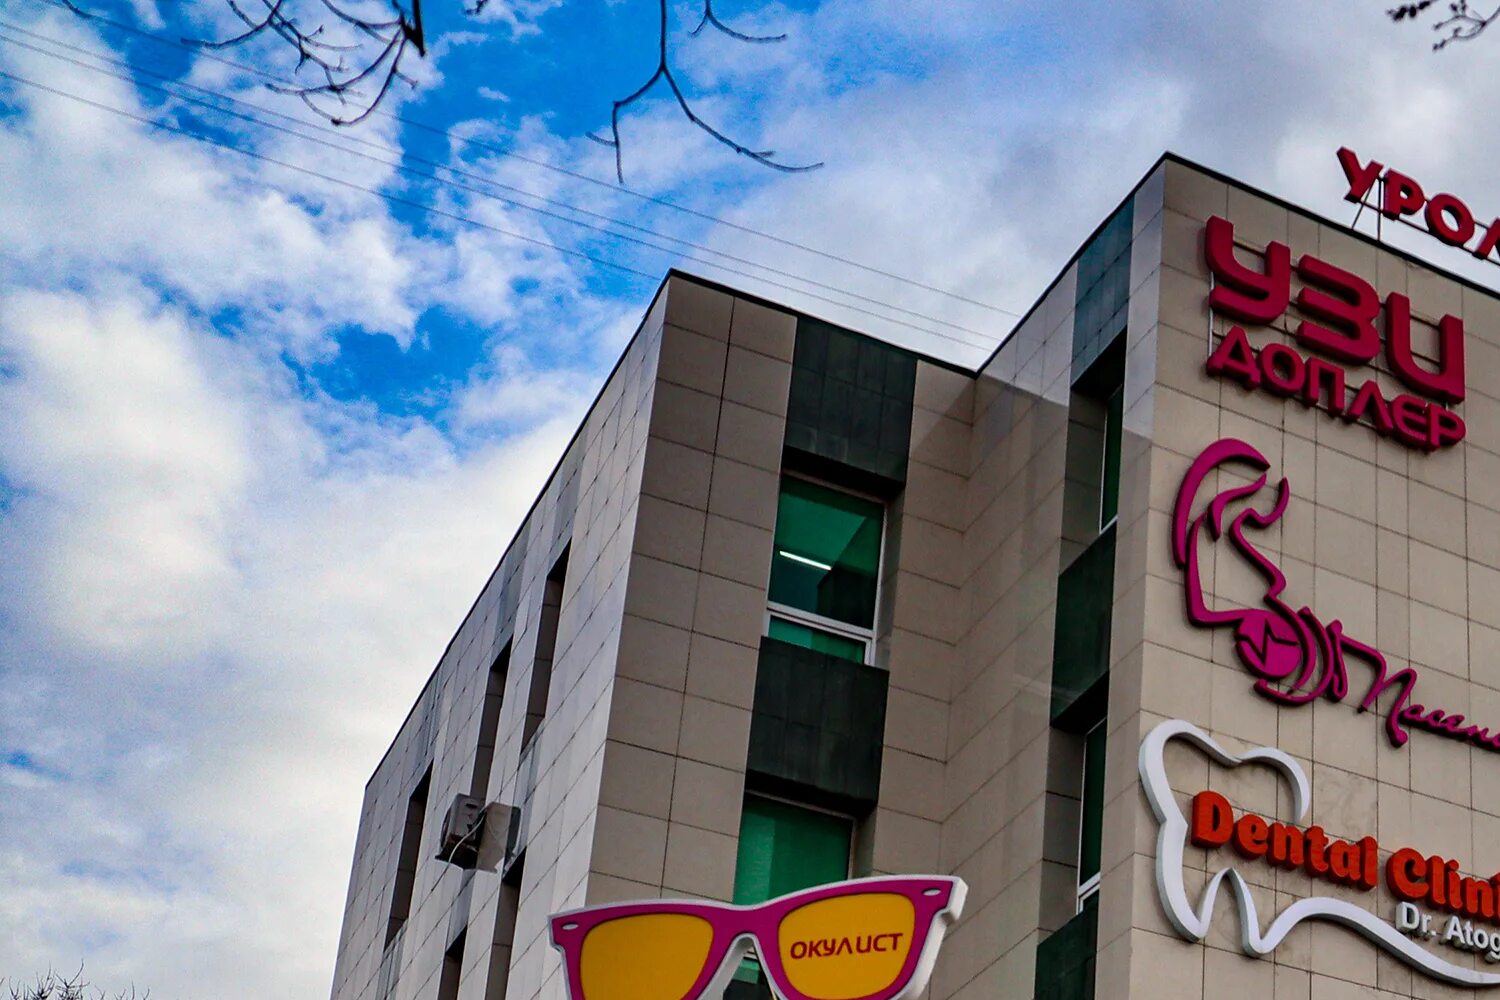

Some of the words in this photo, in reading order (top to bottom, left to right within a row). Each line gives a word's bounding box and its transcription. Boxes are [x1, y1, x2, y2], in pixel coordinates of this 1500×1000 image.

[1205, 215, 1466, 404] УЗИ
[1206, 325, 1467, 453] ДОПЛЕР
[1191, 790, 1379, 891] Dental
[790, 933, 903, 960] ОКУЛИСТ
[1396, 900, 1437, 938] Dr.
